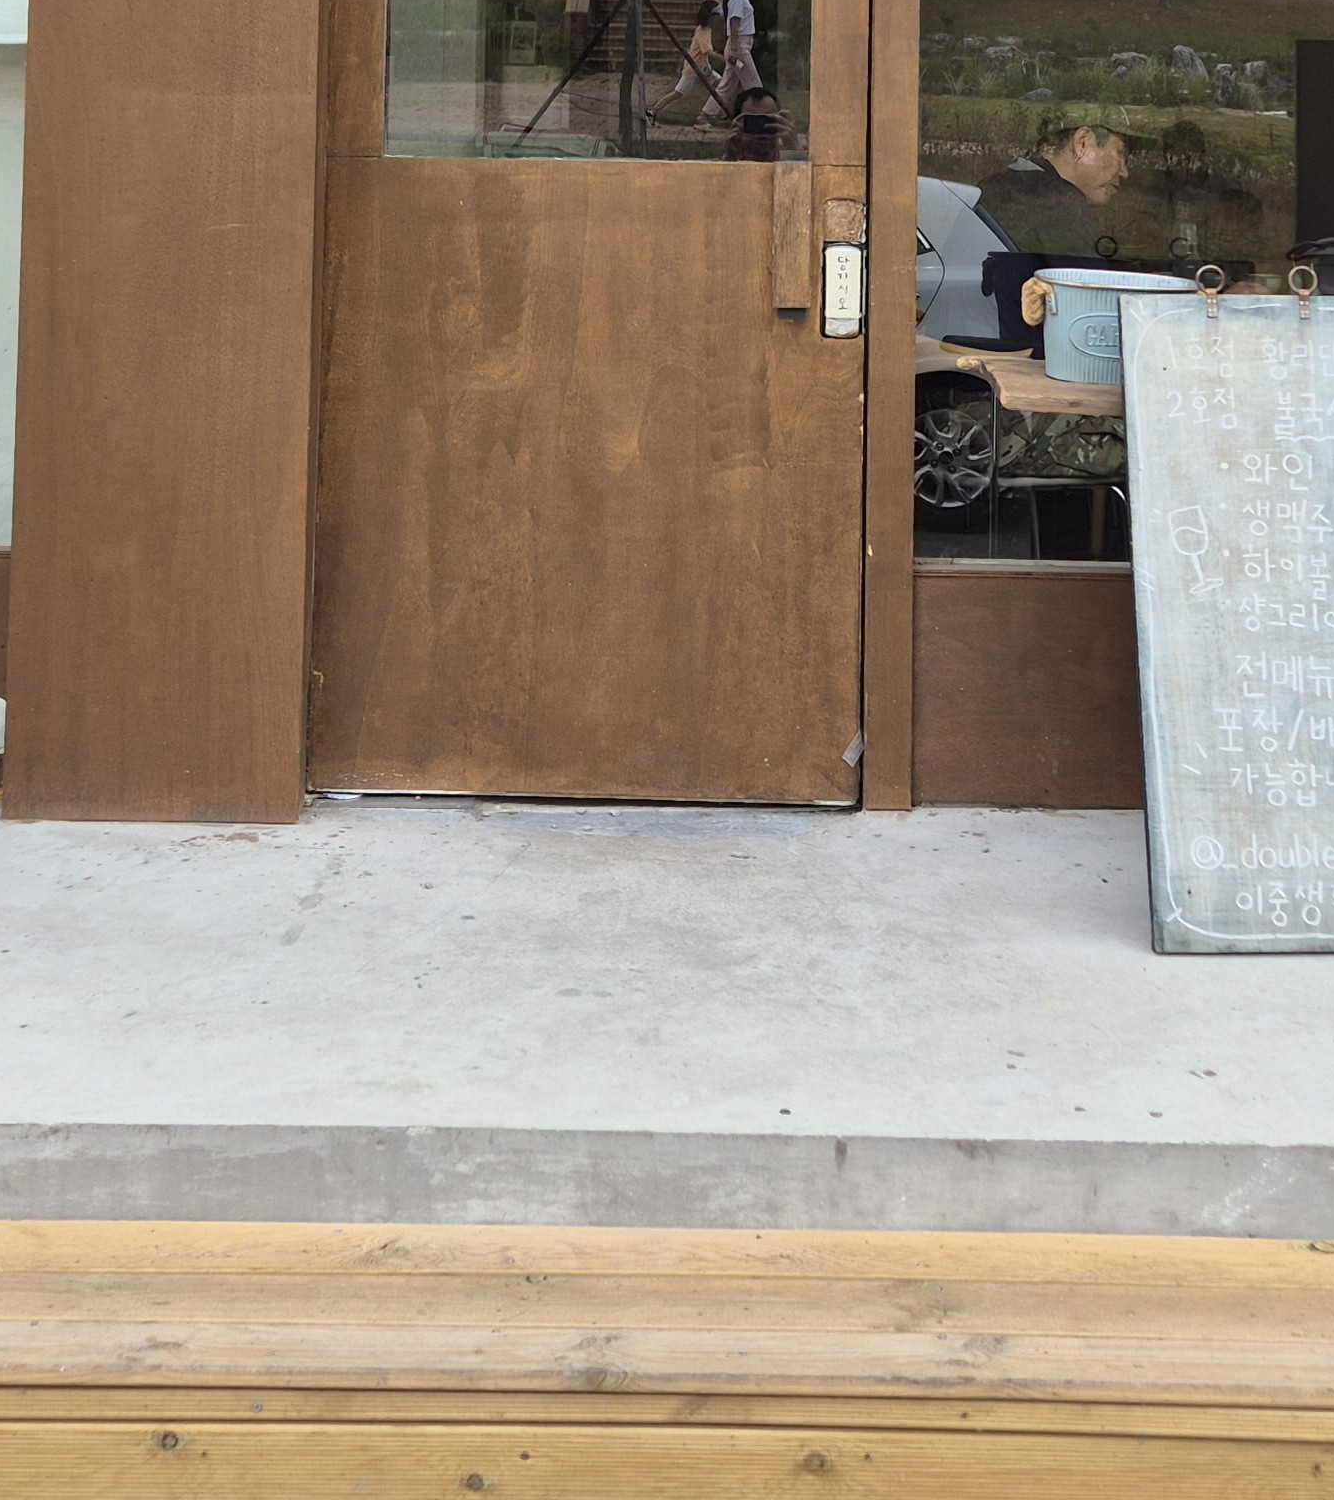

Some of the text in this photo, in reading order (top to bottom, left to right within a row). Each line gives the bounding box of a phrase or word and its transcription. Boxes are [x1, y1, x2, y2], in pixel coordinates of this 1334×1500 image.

[837, 256, 850, 311] 당기시오
[1167, 335, 1235, 378] 1호점
[1166, 388, 1238, 429] 2호점
[1242, 453, 1313, 491] 와인
[1241, 500, 1334, 544] 생맥주
[1241, 543, 1332, 601] 하이볼
